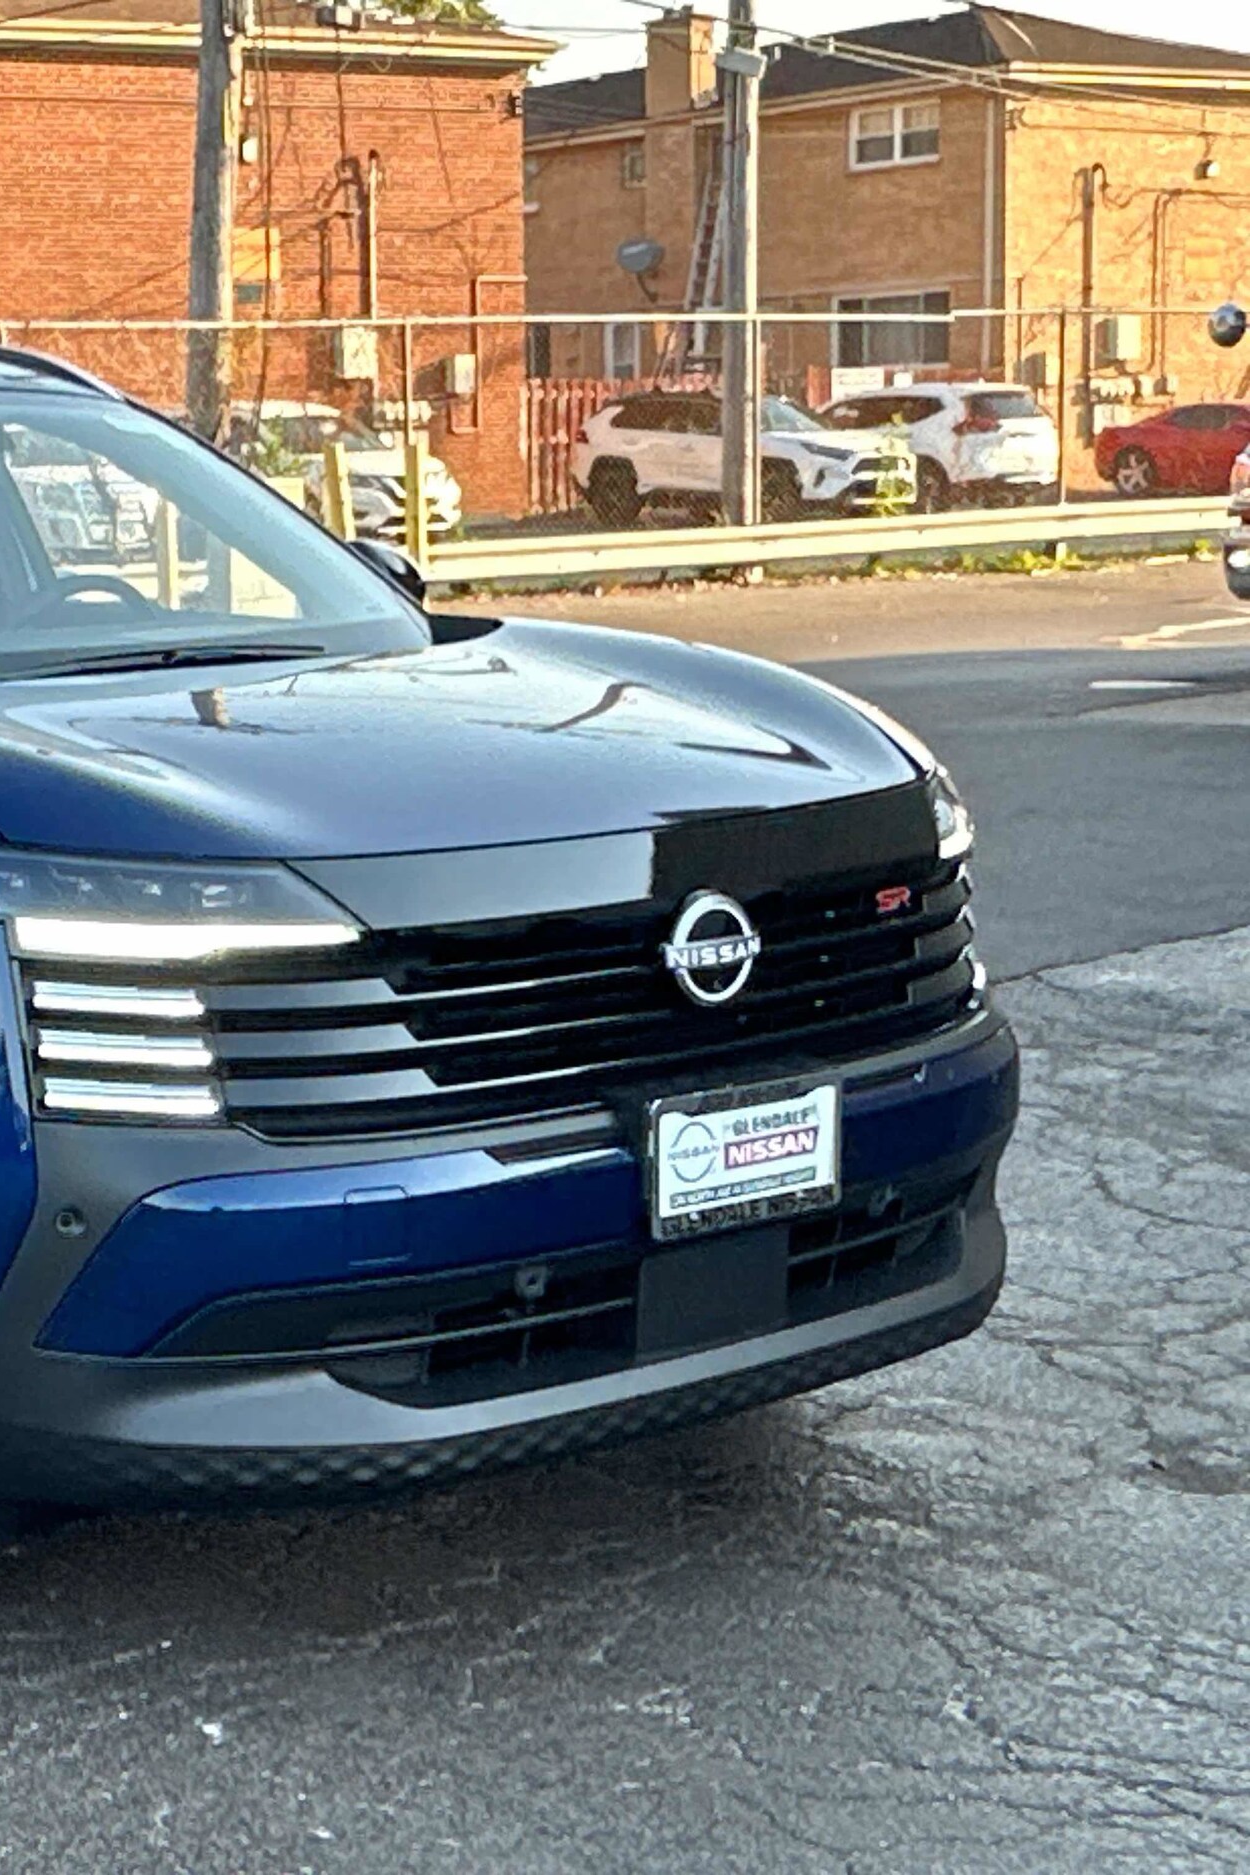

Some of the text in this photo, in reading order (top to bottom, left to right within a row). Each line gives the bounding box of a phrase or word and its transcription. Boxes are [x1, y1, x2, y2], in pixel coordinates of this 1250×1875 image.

[875, 886, 911, 913] SR
[665, 936, 761, 968] NISSAN
[732, 1108, 810, 1136] GLENDALE
[667, 1143, 720, 1161] NISSAN
[728, 1130, 816, 1166] NISSAN
